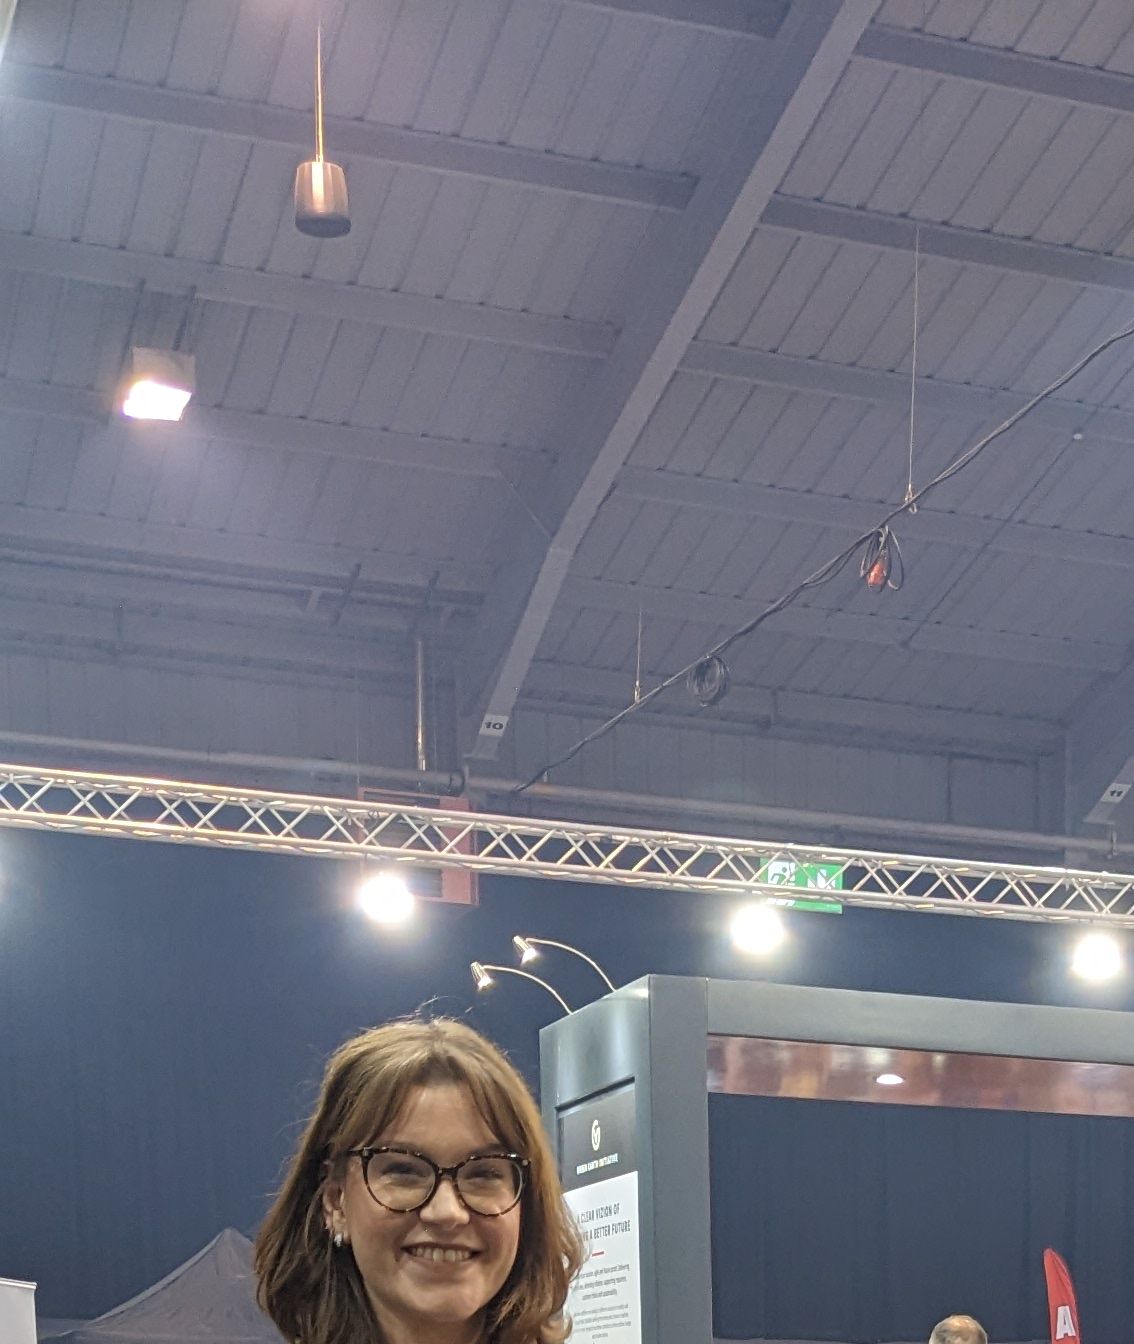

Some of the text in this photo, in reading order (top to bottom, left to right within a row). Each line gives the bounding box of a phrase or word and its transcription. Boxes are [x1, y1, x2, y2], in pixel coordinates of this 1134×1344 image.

[485, 721, 504, 730] 10
[581, 1209, 595, 1223] CLEAR
[594, 1224, 611, 1239] BETTER
[612, 1219, 631, 1235] FUTURE
